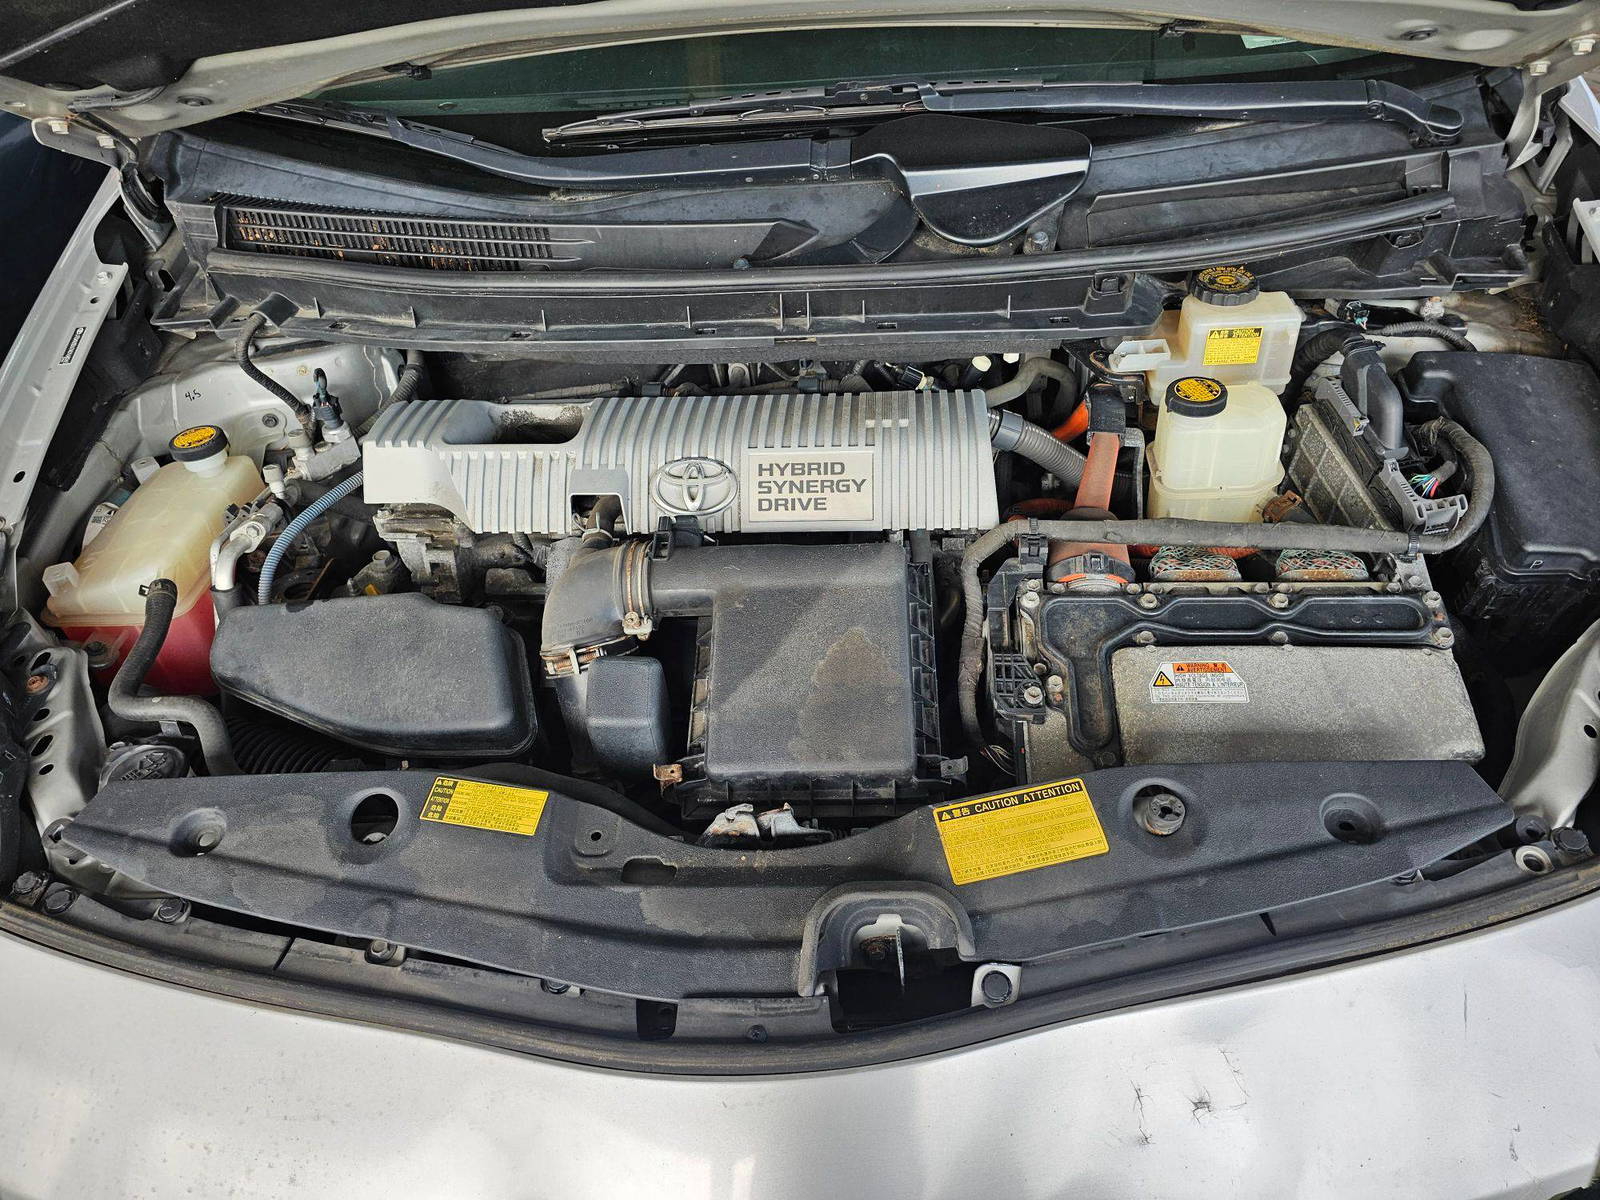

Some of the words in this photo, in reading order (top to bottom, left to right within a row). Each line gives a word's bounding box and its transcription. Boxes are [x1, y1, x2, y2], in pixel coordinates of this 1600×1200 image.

[757, 461, 846, 476] HYBRID
[757, 478, 867, 494] SYNERGY
[757, 497, 828, 512] DRIVE
[974, 796, 1019, 813] CAUTION
[1023, 782, 1080, 803] ATTENTION
